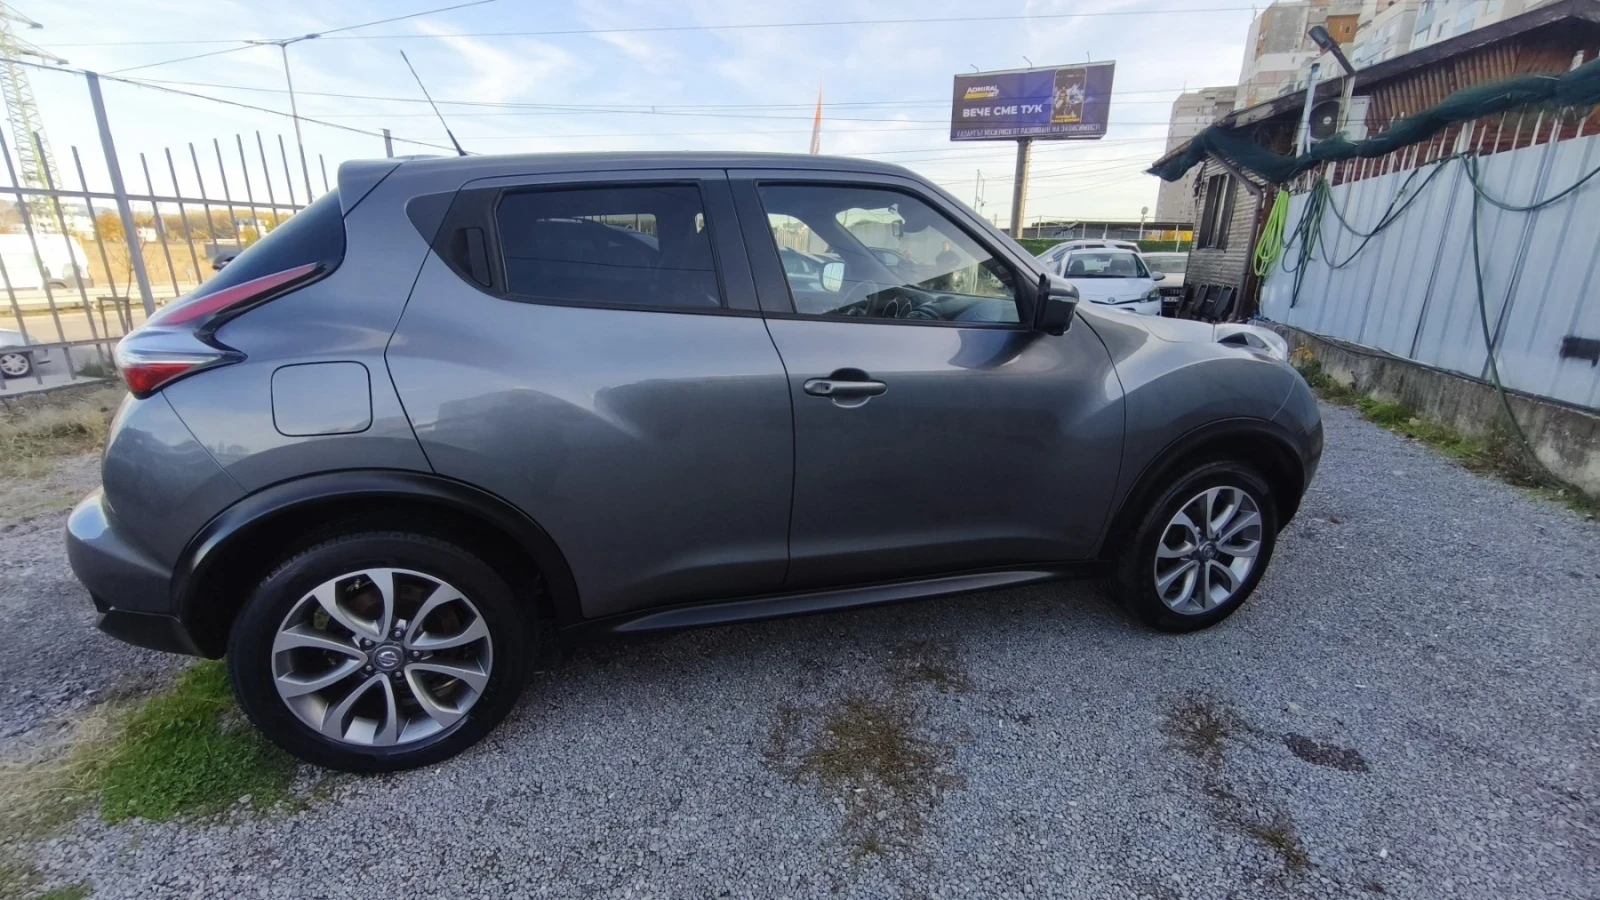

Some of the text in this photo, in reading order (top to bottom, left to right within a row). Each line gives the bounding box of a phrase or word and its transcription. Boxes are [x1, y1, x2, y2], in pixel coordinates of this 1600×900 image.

[966, 85, 999, 94] ADMIRAL
[962, 103, 1043, 118] ВЕЧЕ СМЕ ТУК
